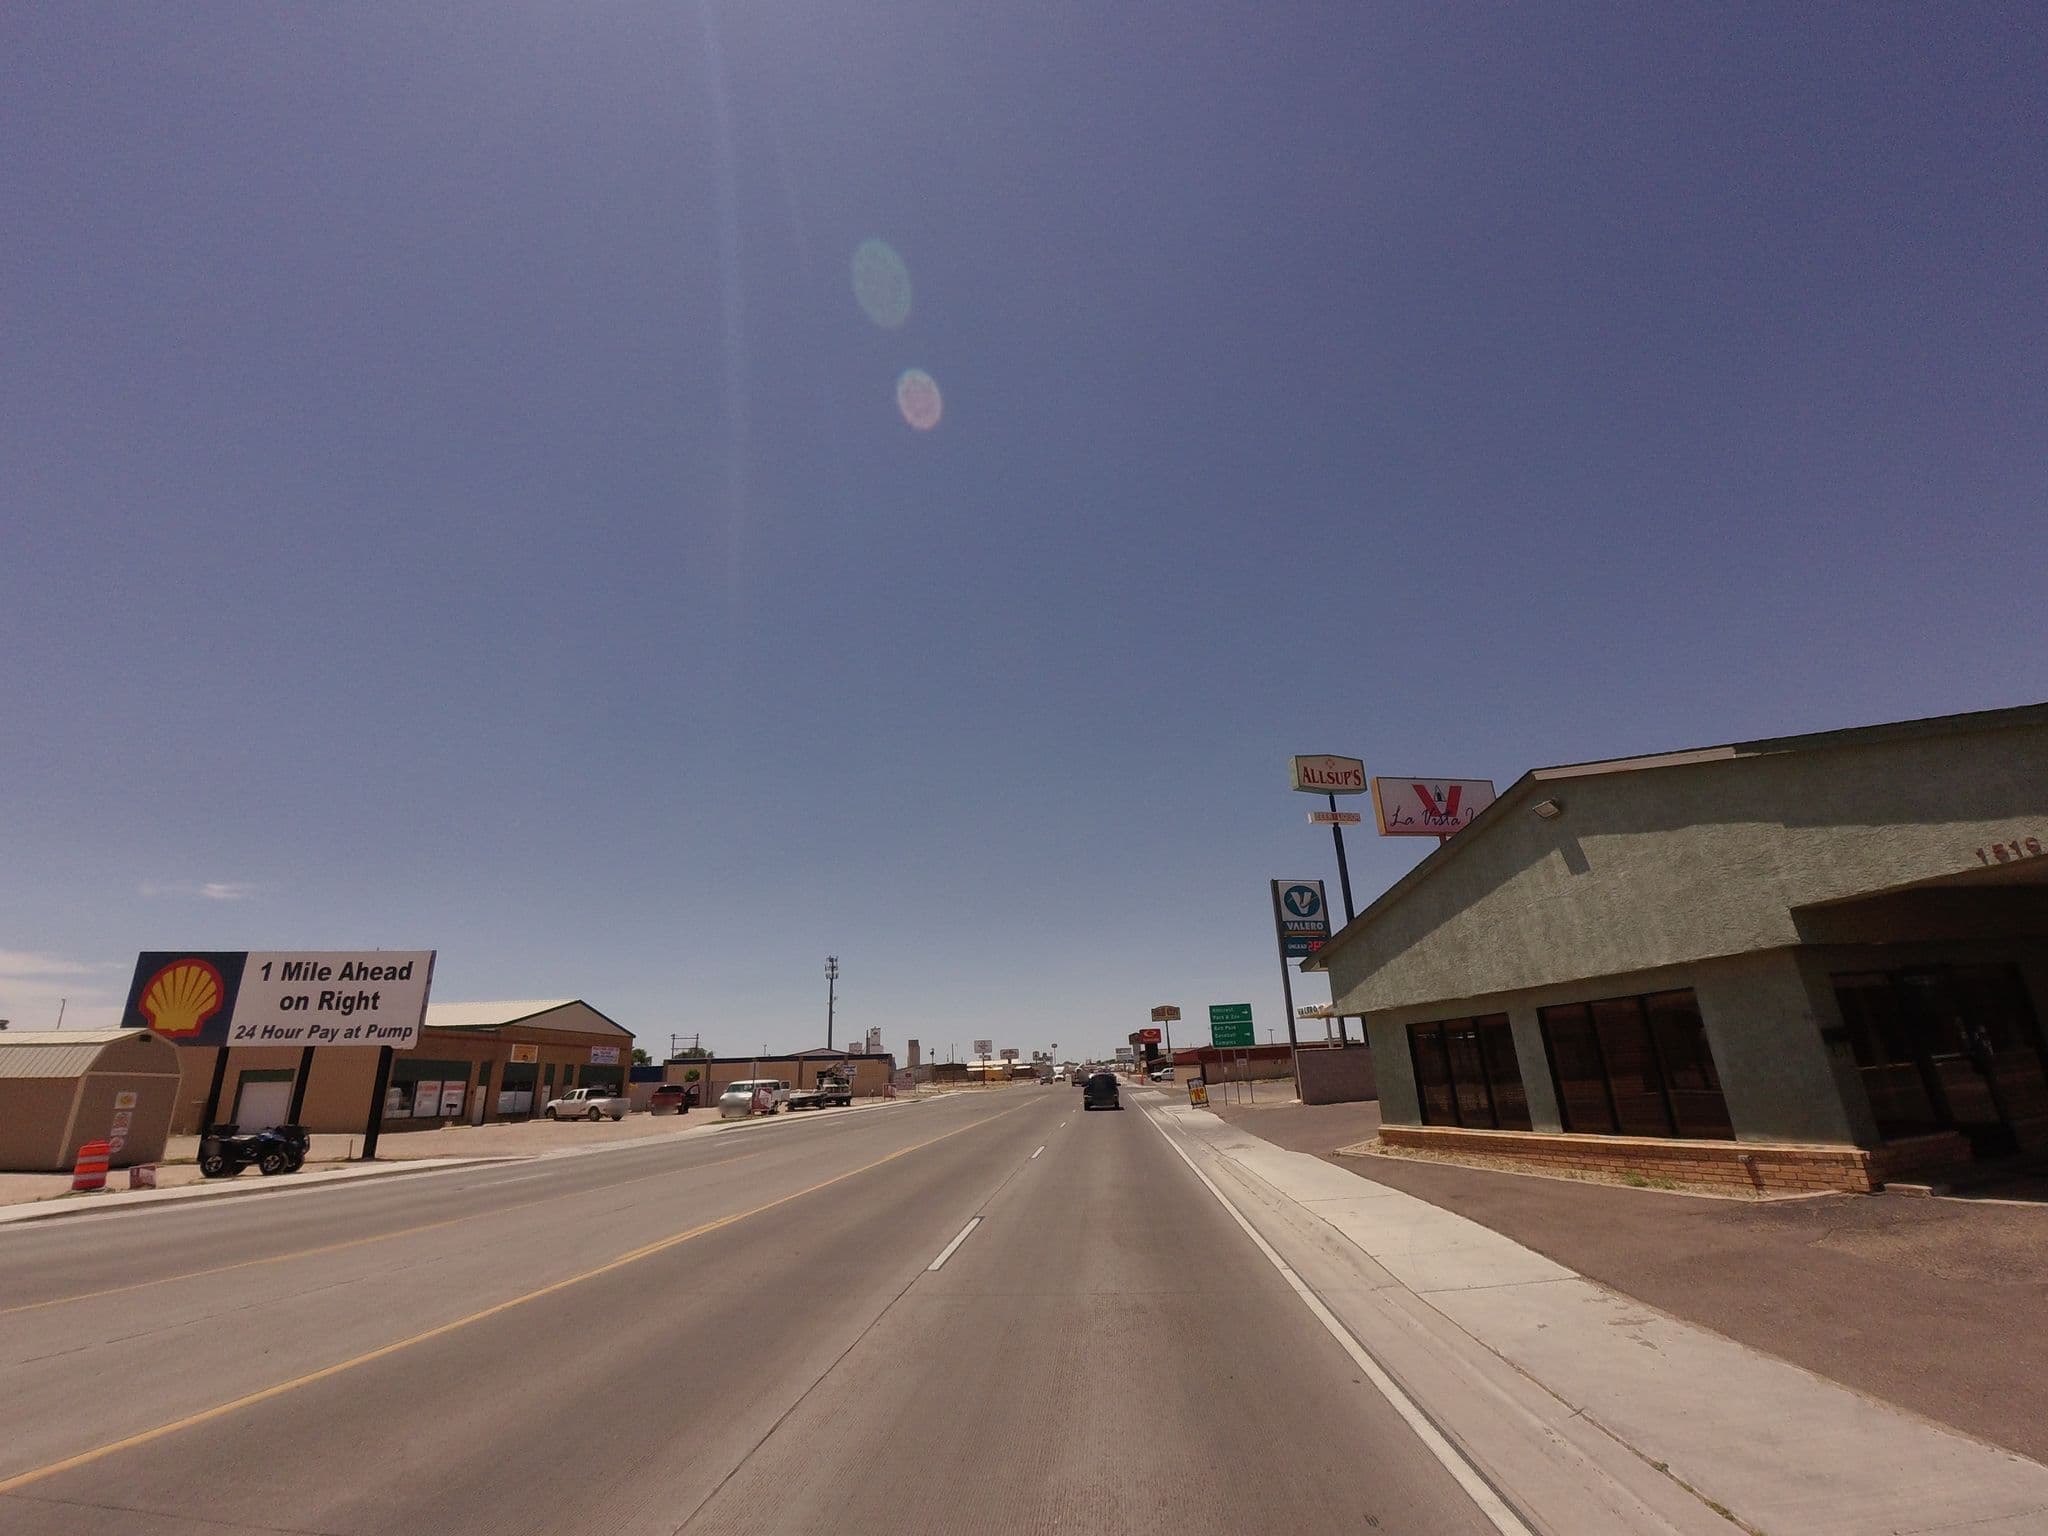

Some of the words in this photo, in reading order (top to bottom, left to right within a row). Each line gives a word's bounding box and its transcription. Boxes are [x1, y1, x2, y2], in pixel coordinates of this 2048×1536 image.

[1303, 766, 1361, 786] ALLSUP'S
[1390, 805, 1415, 827] La
[1421, 808, 1461, 826] Vista
[1286, 922, 1324, 931] VALERO
[260, 961, 274, 981] 1
[280, 961, 332, 981] Mile
[338, 960, 414, 981] Ahead
[279, 994, 310, 1011] on
[317, 990, 381, 1015] Right
[234, 1025, 256, 1040] 24
[260, 1025, 304, 1040] Hour
[307, 1025, 339, 1042] Pay
[345, 1026, 362, 1039] at
[365, 1024, 414, 1042] Pump
